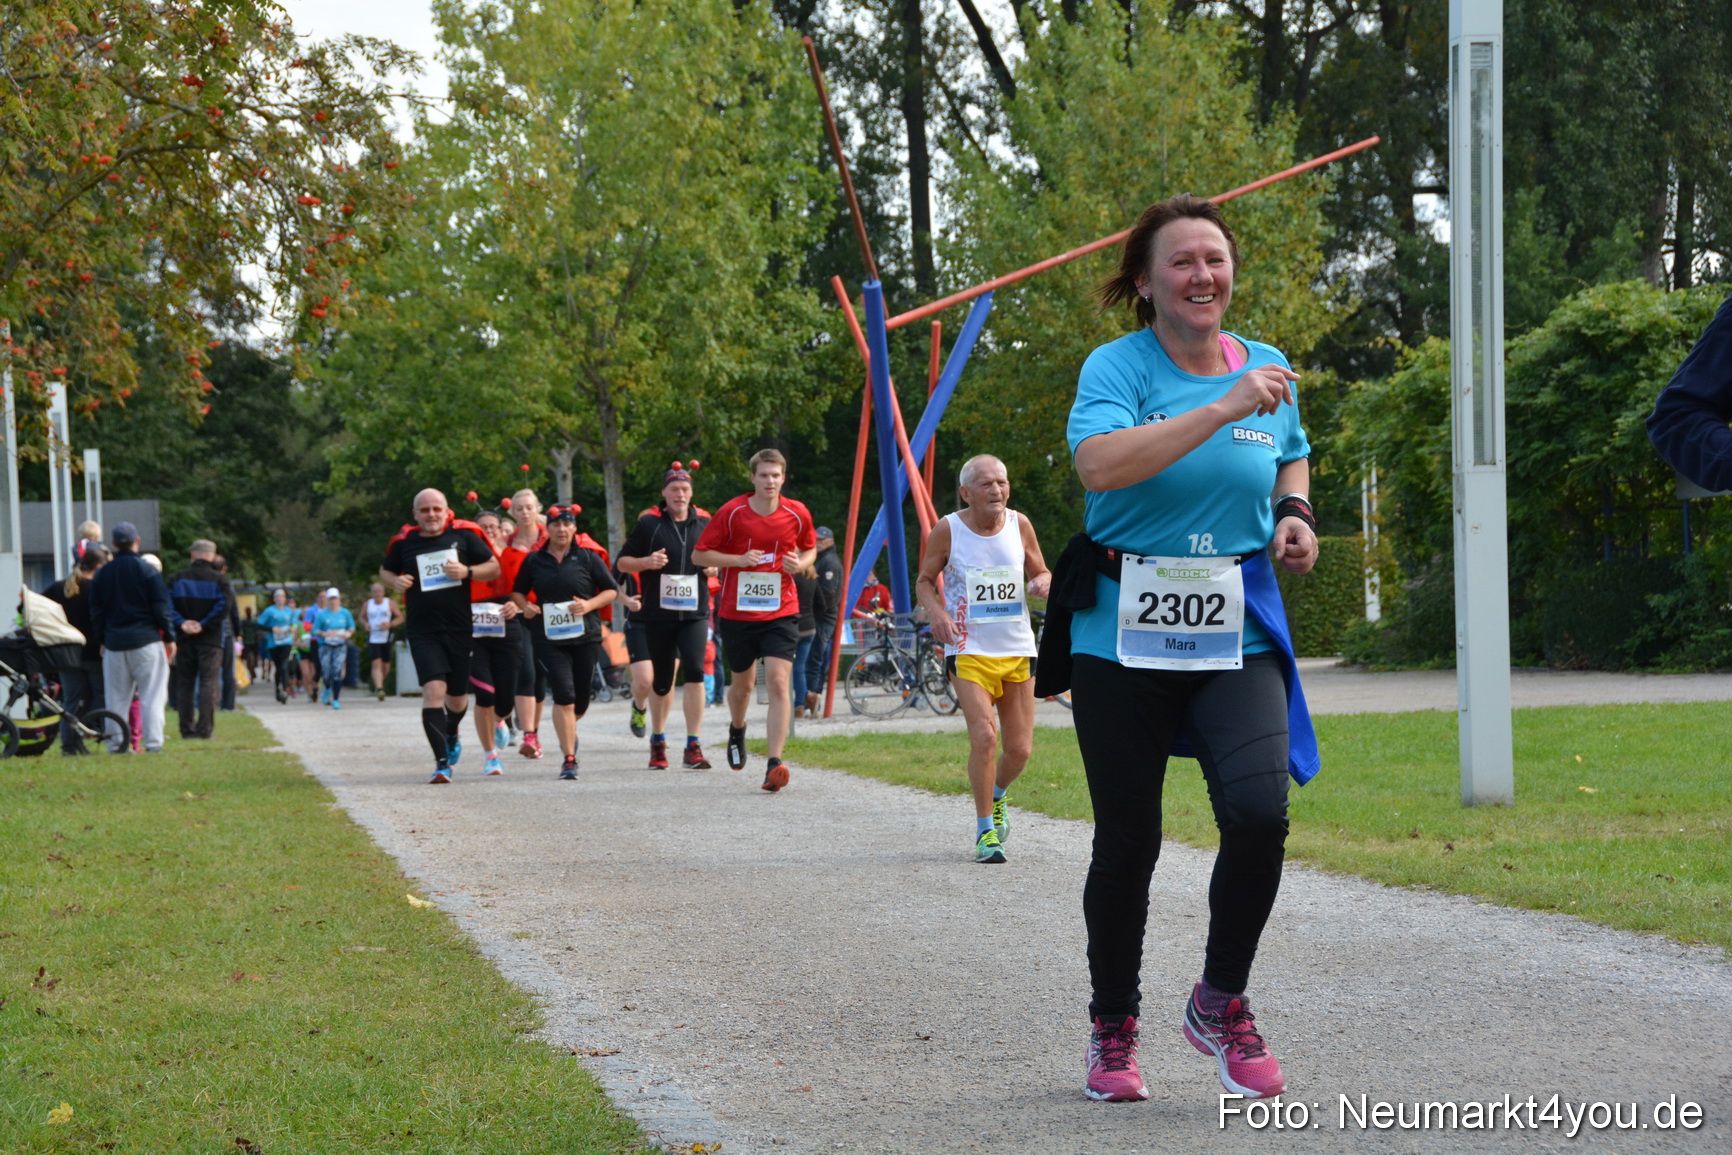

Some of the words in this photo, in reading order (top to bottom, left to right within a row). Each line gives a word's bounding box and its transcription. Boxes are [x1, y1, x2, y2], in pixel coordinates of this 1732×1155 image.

[1232, 427, 1275, 448] BOCK
[1188, 533, 1217, 555] 18.
[425, 561, 449, 576] 251
[1169, 568, 1210, 578] BOCK
[666, 585, 692, 597] 2139
[744, 583, 774, 596] 2455
[975, 583, 1016, 602] 2182
[986, 606, 1009, 614] Andreas
[1138, 592, 1226, 627] 2302
[472, 613, 499, 624] 2155
[550, 613, 576, 626] 2041
[1165, 638, 1196, 651] Mara
